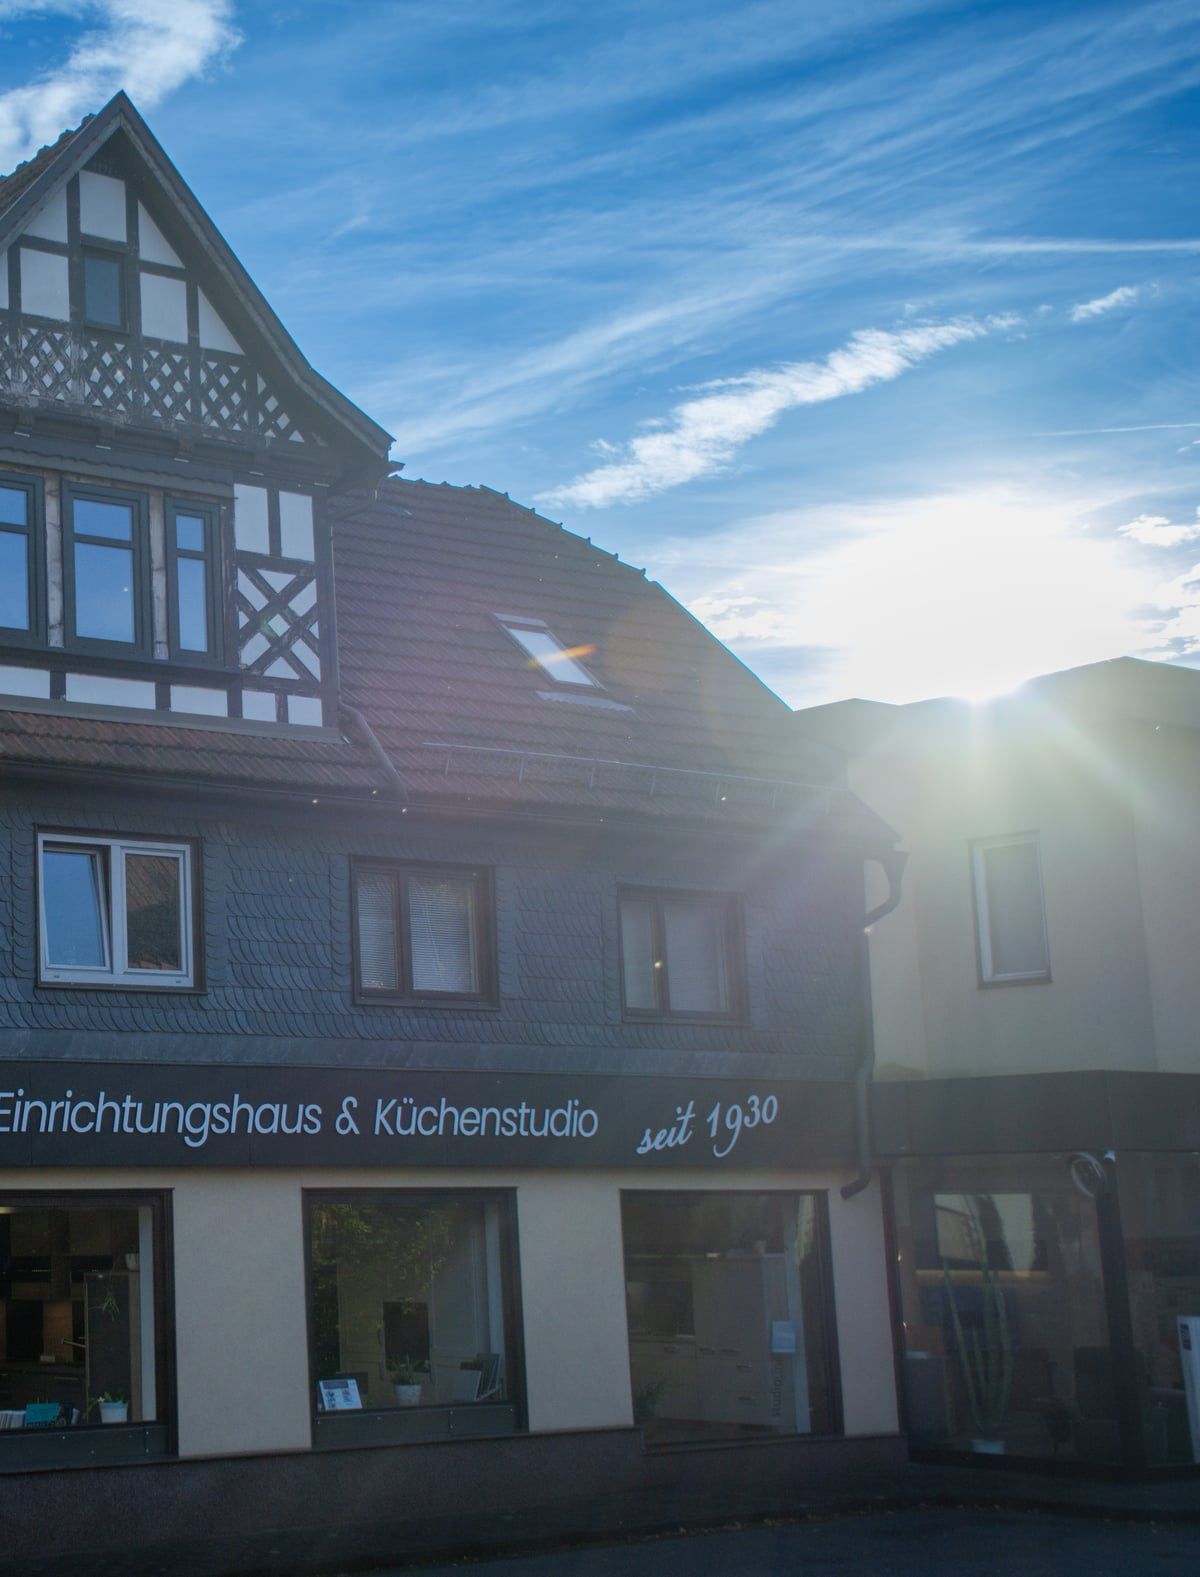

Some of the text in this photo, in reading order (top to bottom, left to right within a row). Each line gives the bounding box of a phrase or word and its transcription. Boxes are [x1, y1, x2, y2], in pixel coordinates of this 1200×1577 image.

[335, 1096, 360, 1135] &
[374, 1097, 599, 1137] Küchenstudio
[636, 1094, 778, 1157] seit 1930
